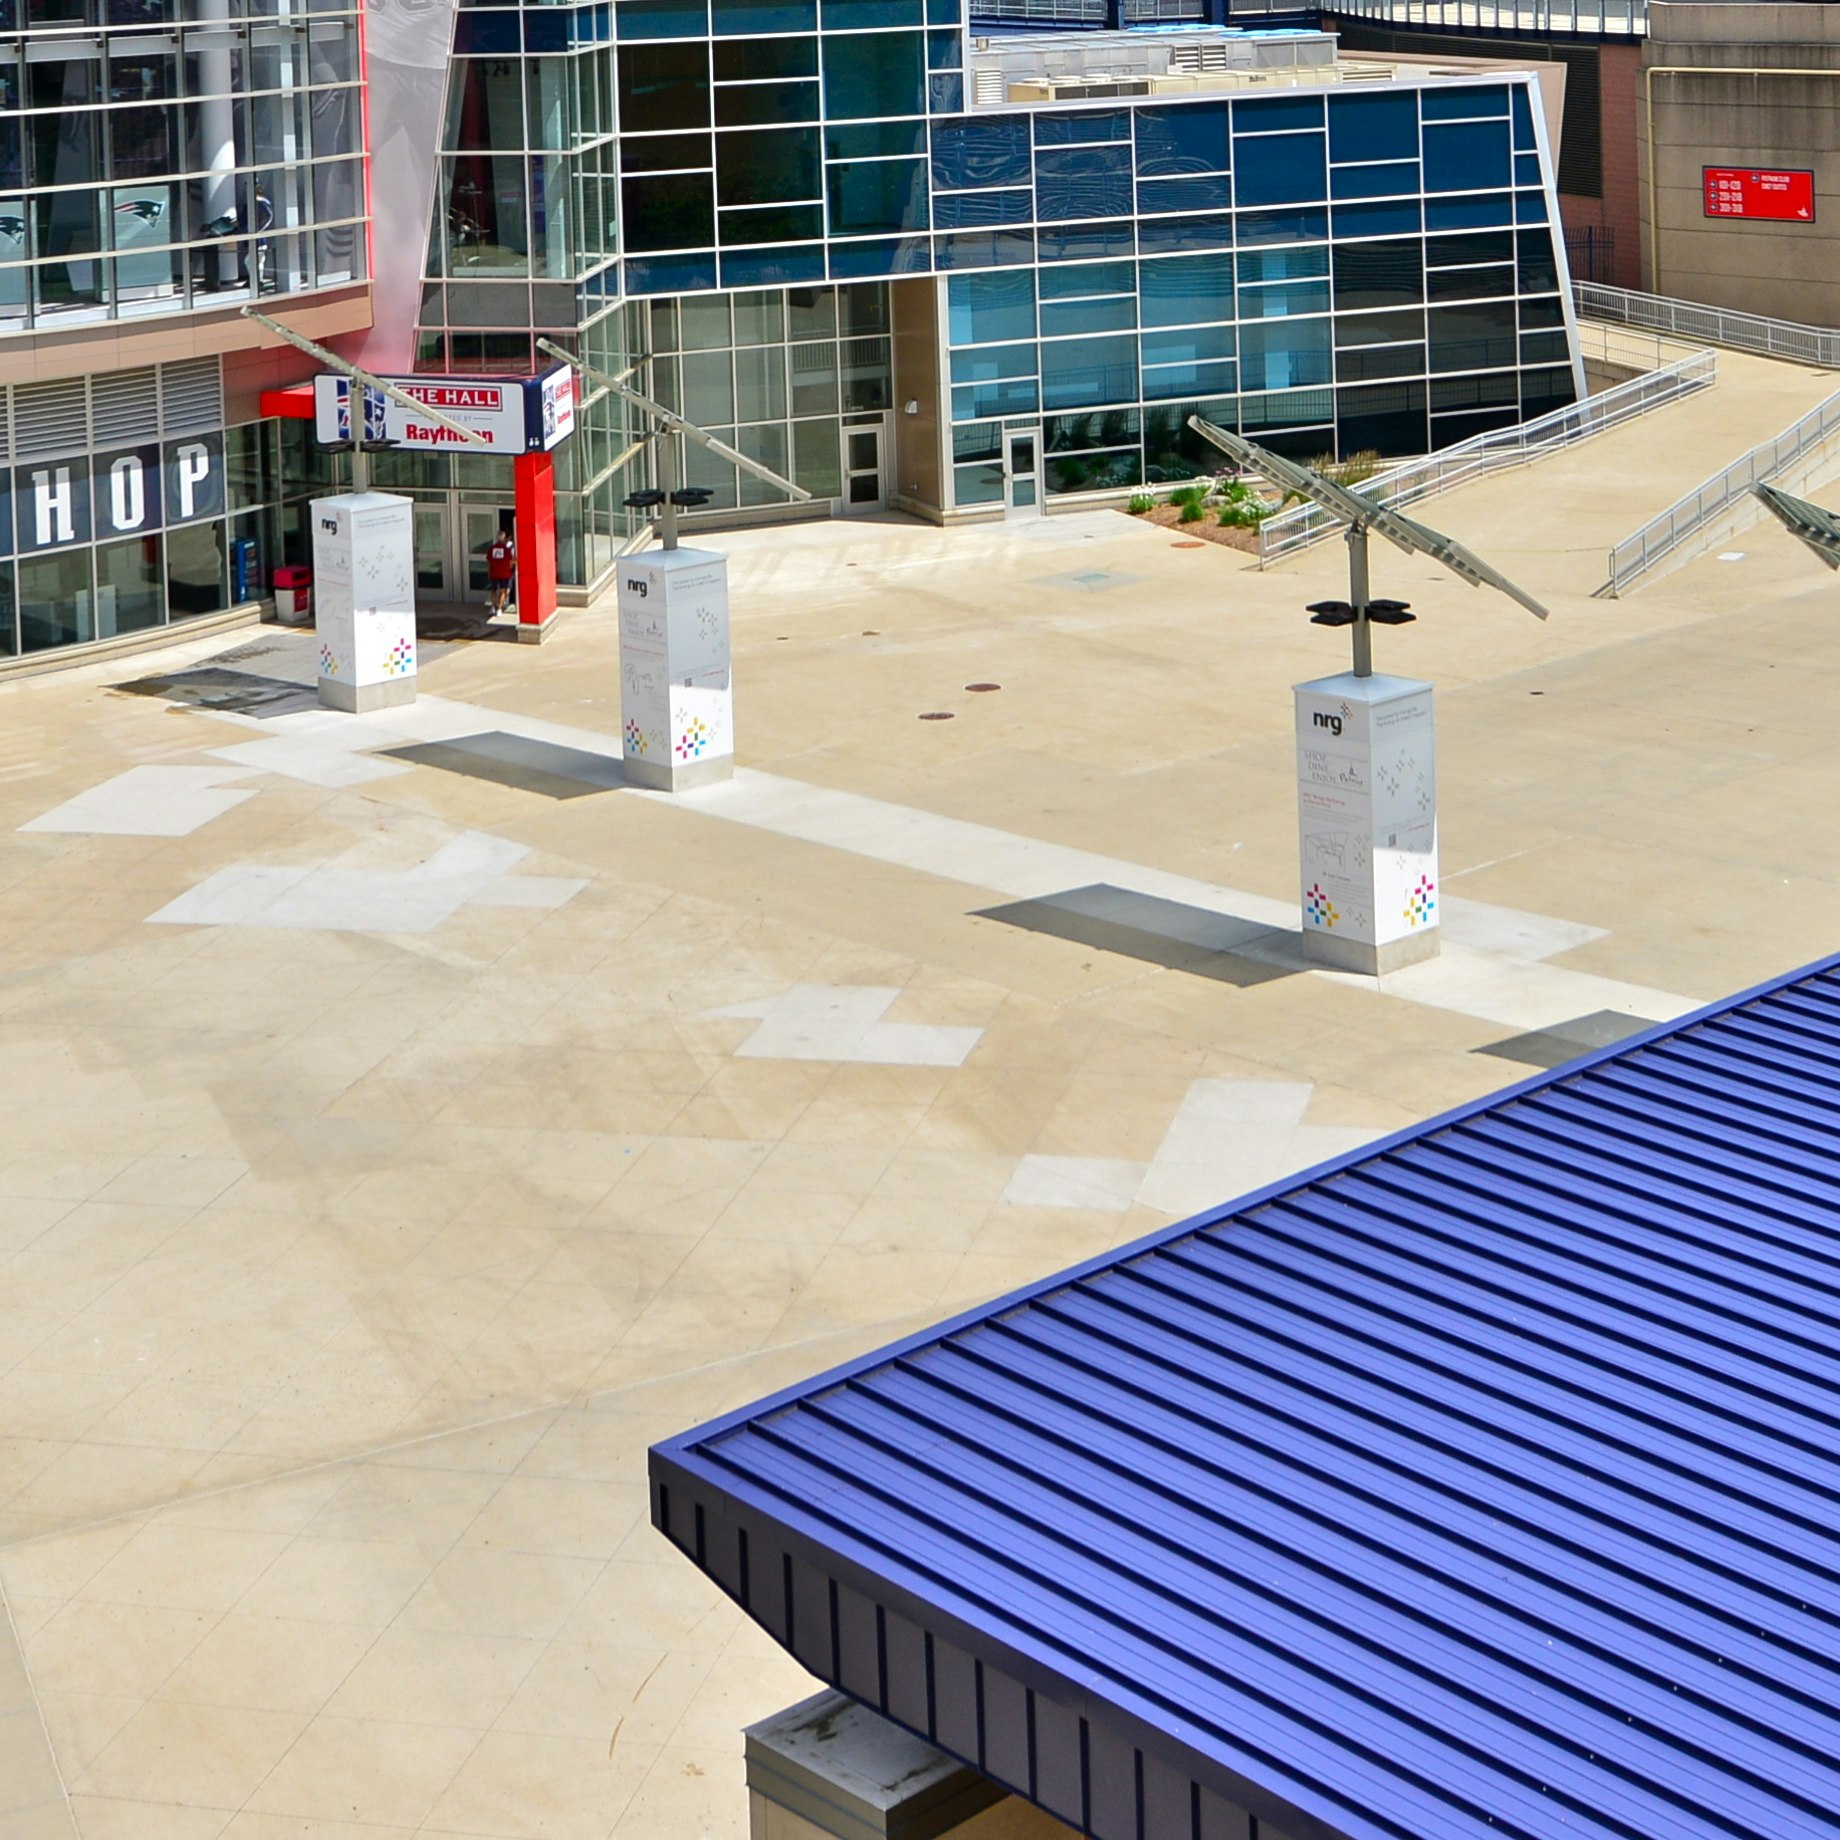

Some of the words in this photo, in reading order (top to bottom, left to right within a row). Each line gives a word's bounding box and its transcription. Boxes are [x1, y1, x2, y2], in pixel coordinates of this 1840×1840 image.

[445, 390, 498, 405] HALL
[321, 518, 337, 535] nrg
[627, 579, 647, 598] nrg
[1313, 712, 1342, 736] nrg
